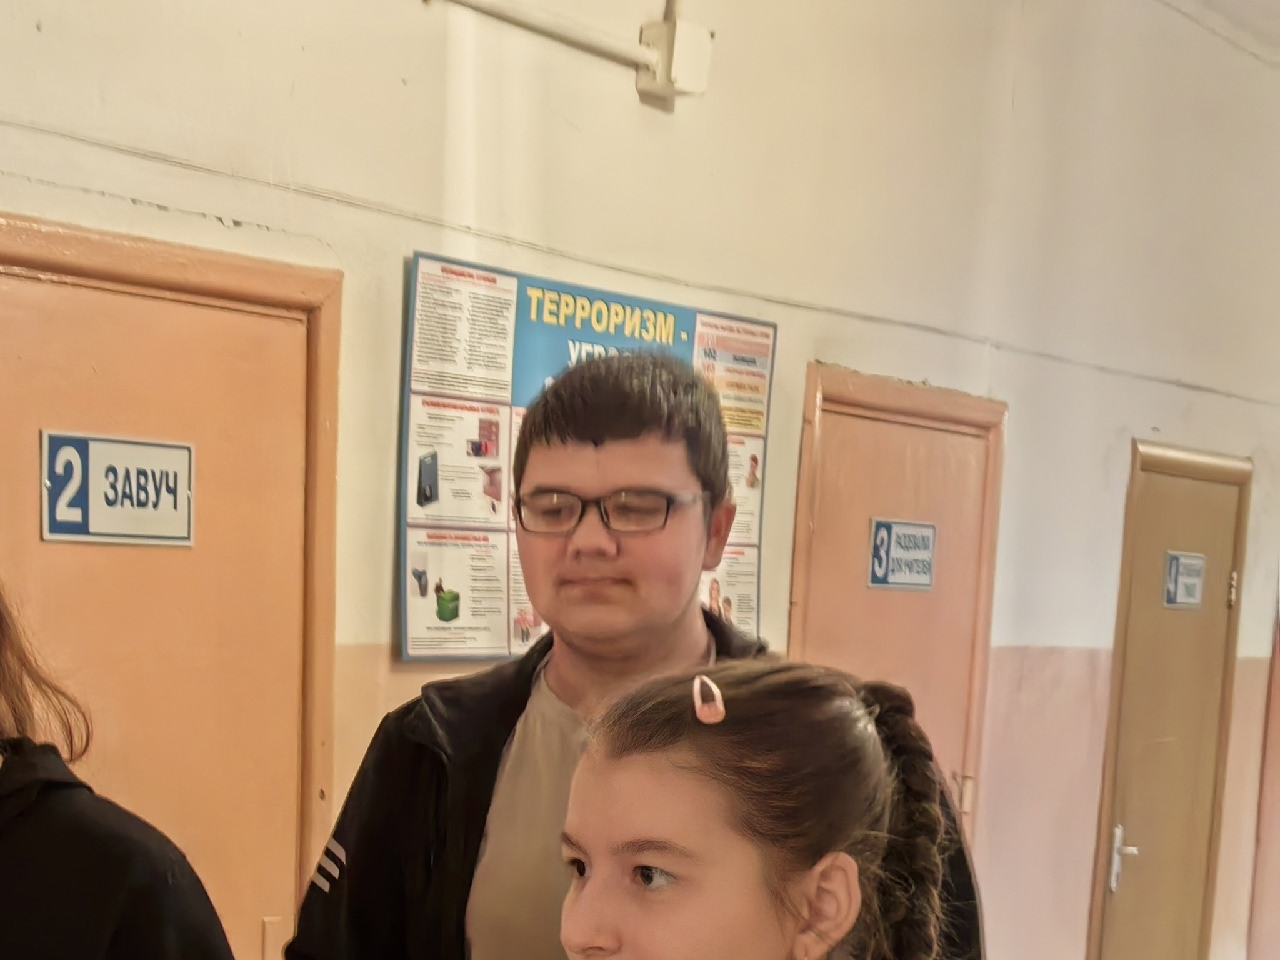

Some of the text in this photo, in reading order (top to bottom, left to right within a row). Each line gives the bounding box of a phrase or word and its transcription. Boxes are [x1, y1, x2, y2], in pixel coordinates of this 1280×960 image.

[526, 286, 675, 346] ТЕРРОРИЗМ
[567, 339, 632, 369] УГР
[54, 445, 178, 523] 2 ЗАВУЧ
[874, 527, 888, 578] 3
